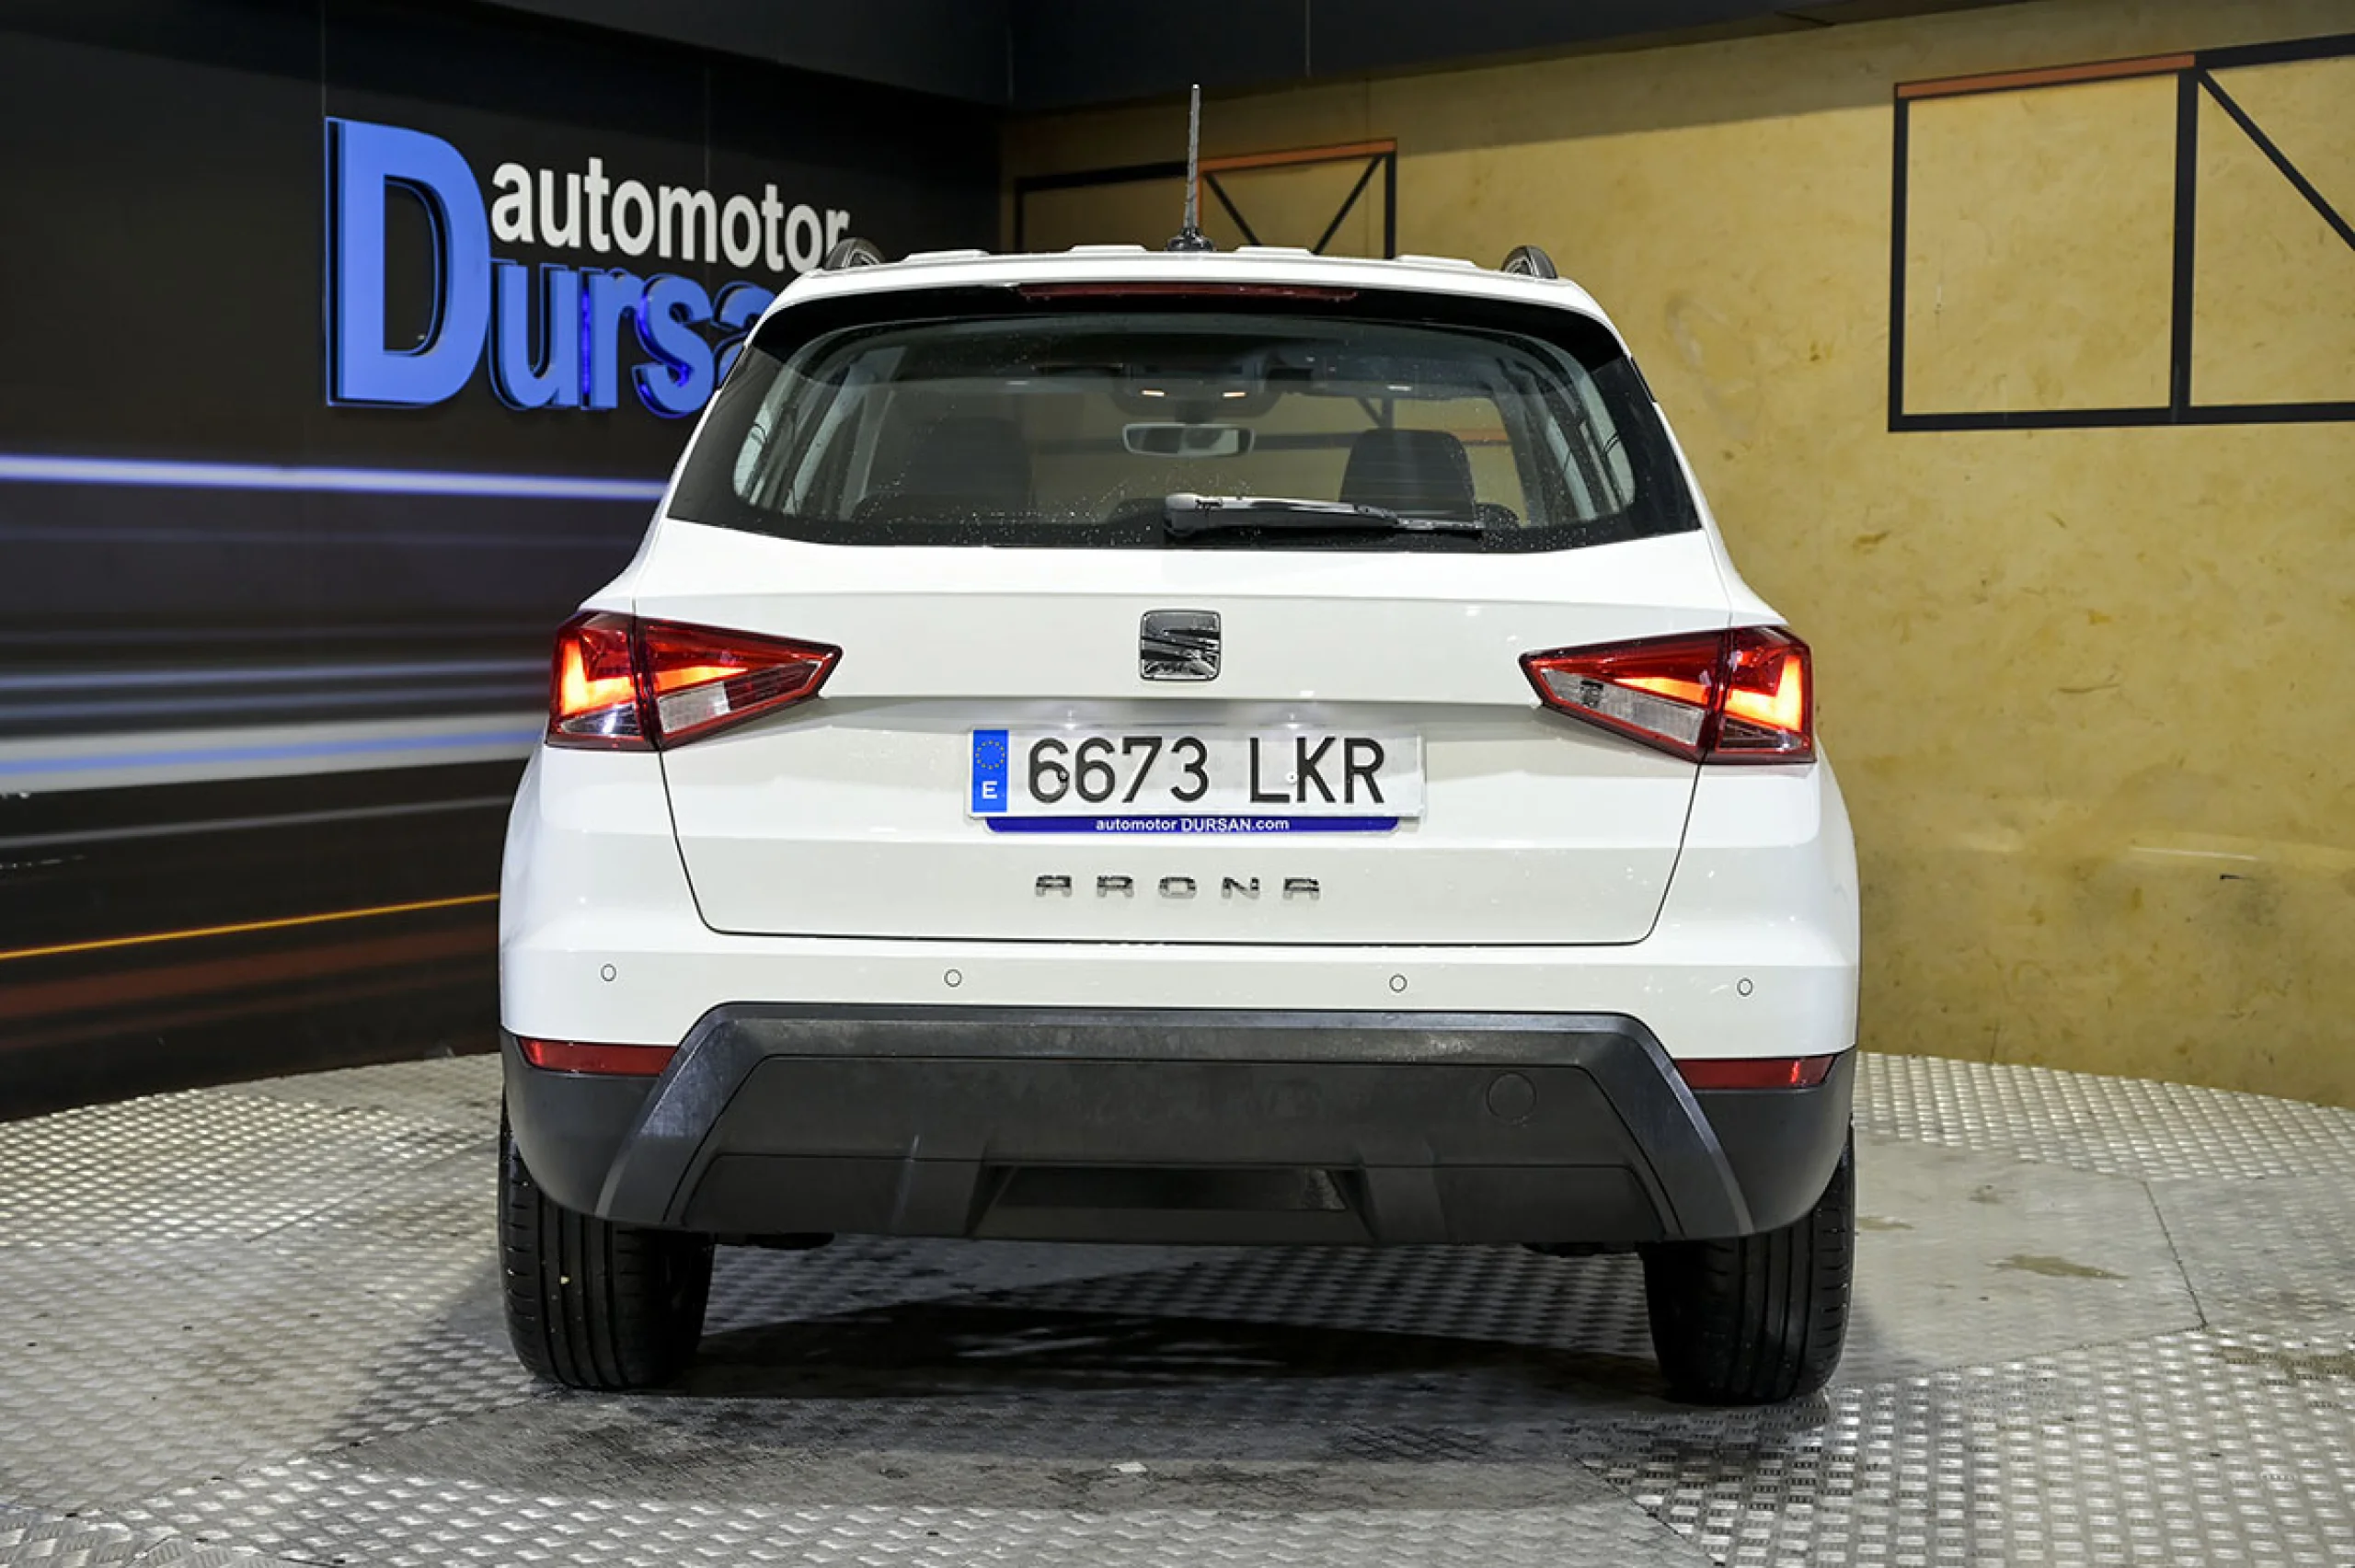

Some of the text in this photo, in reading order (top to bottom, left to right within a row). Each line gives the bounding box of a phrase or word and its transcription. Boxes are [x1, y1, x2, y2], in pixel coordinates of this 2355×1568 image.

[490, 156, 851, 273] automotor
[1027, 736, 1385, 805] 6673 LKR
[982, 780, 998, 799] E
[1096, 818, 1290, 831] automotor DURSAN.com
[1035, 874, 1321, 899] ARONA
